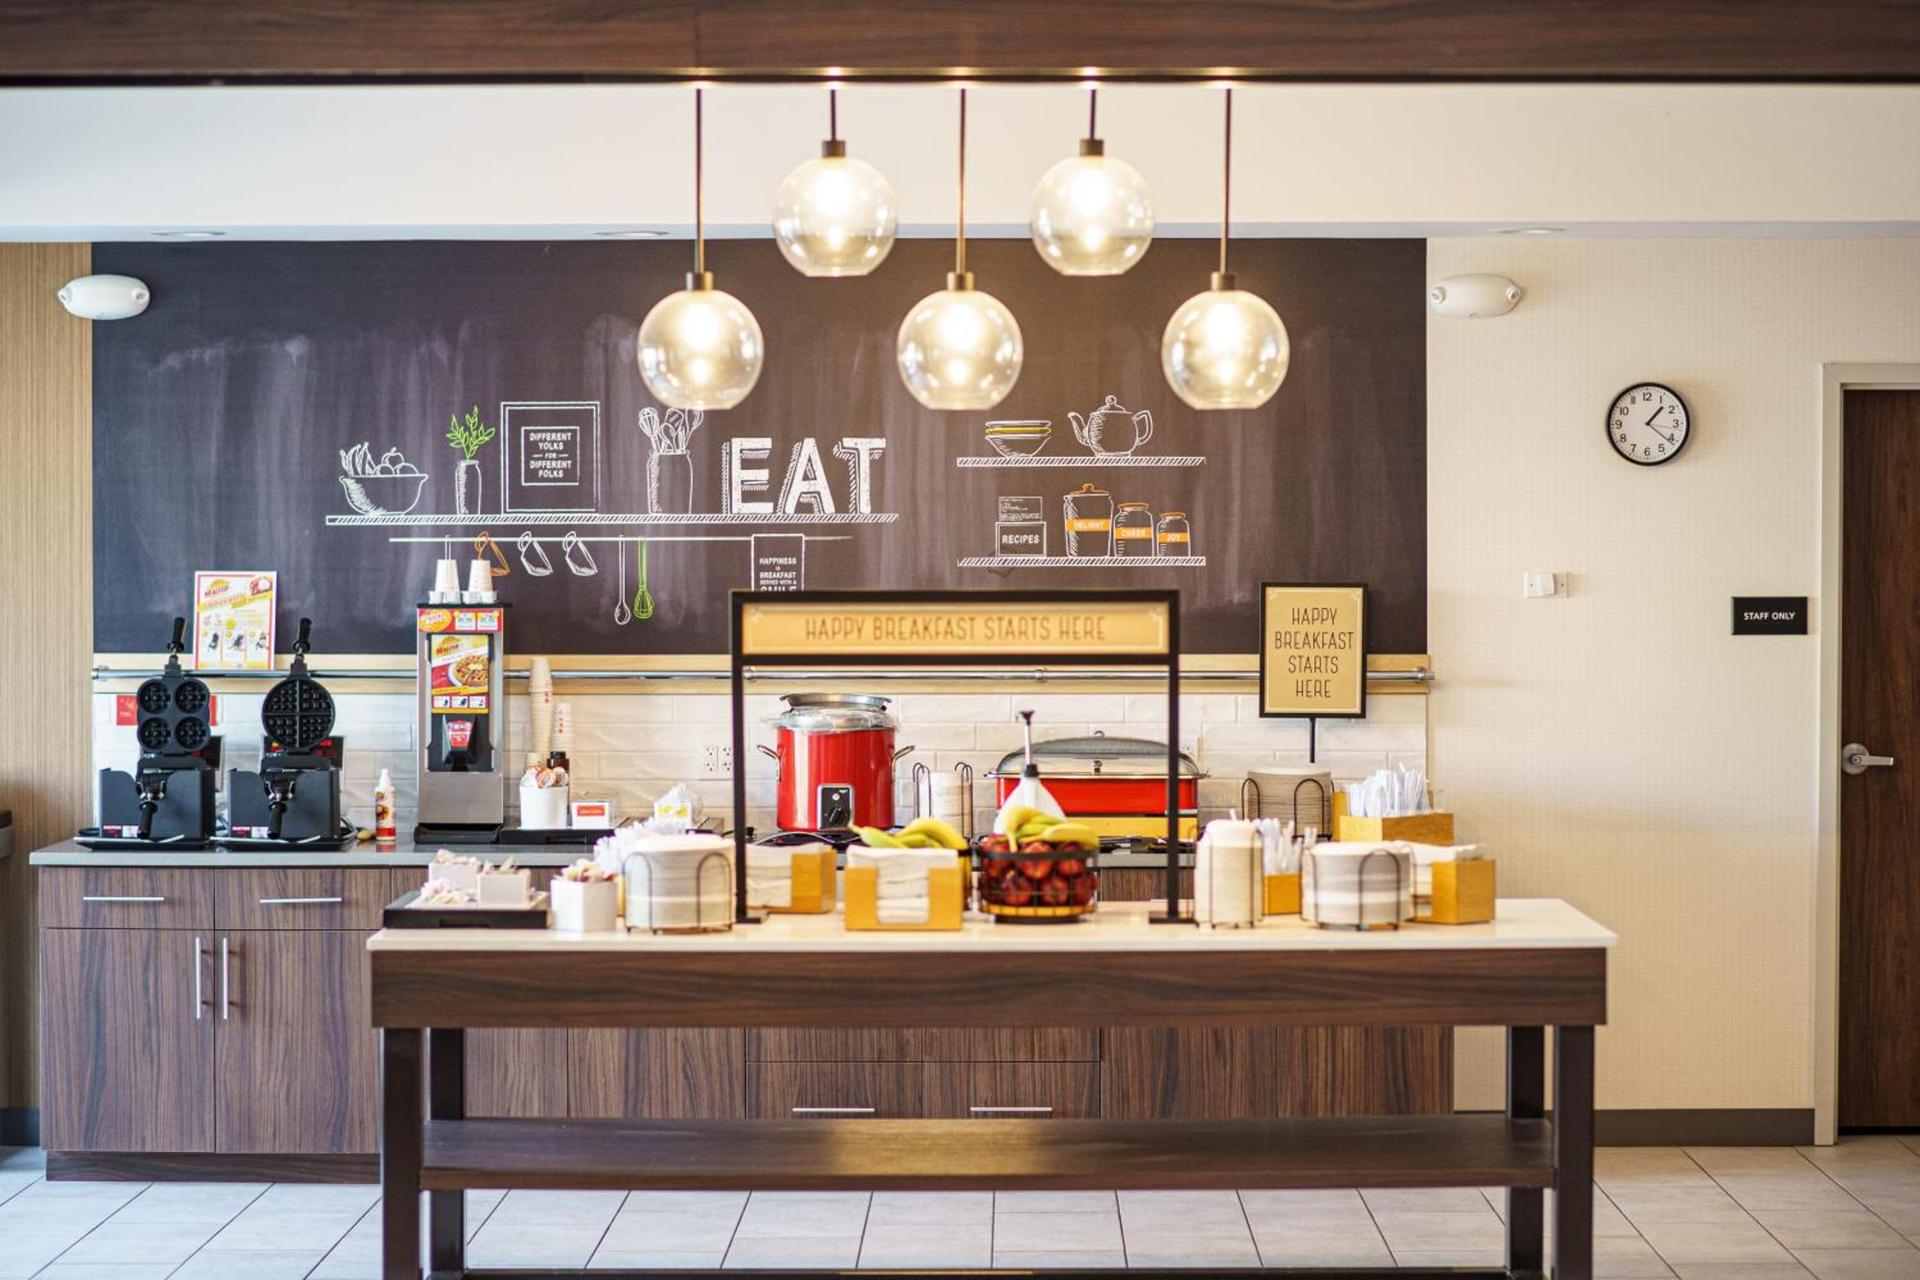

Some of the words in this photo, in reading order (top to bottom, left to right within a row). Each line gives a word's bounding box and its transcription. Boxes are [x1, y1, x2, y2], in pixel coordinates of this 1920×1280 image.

[1642, 392, 1652, 401] 12
[1619, 406, 1629, 416] 10
[1668, 405, 1675, 414] 2
[1615, 420, 1623, 429] 9
[1673, 419, 1679, 428] 3
[529, 432, 572, 441] DIFFERENT
[1620, 433, 1627, 443] 8
[1668, 433, 1675, 442] 4
[538, 442, 564, 450] YOLKS
[1630, 443, 1637, 452] 7
[1658, 443, 1665, 453] 5
[1644, 447, 1651, 456] 6
[529, 460, 572, 469] DIFFERENT
[538, 469, 564, 478] FOLKS
[722, 437, 887, 514] EAT
[1002, 534, 1040, 544] RECIPES
[1167, 533, 1181, 542] JOY
[760, 557, 797, 565] HAPPINESS
[760, 571, 796, 579] BREAKFAST
[1291, 607, 1337, 625] HAPPY
[1743, 612, 1769, 620] STAFF
[1771, 612, 1795, 620] ONLY
[805, 616, 865, 641] HAPPY
[873, 616, 976, 641] BREAKFAST
[984, 616, 1051, 641] STARTS
[1059, 616, 1106, 641] HERE
[1274, 631, 1355, 650] BREAKFAST
[1288, 655, 1339, 674] STARTS
[1296, 679, 1332, 698] HERE
